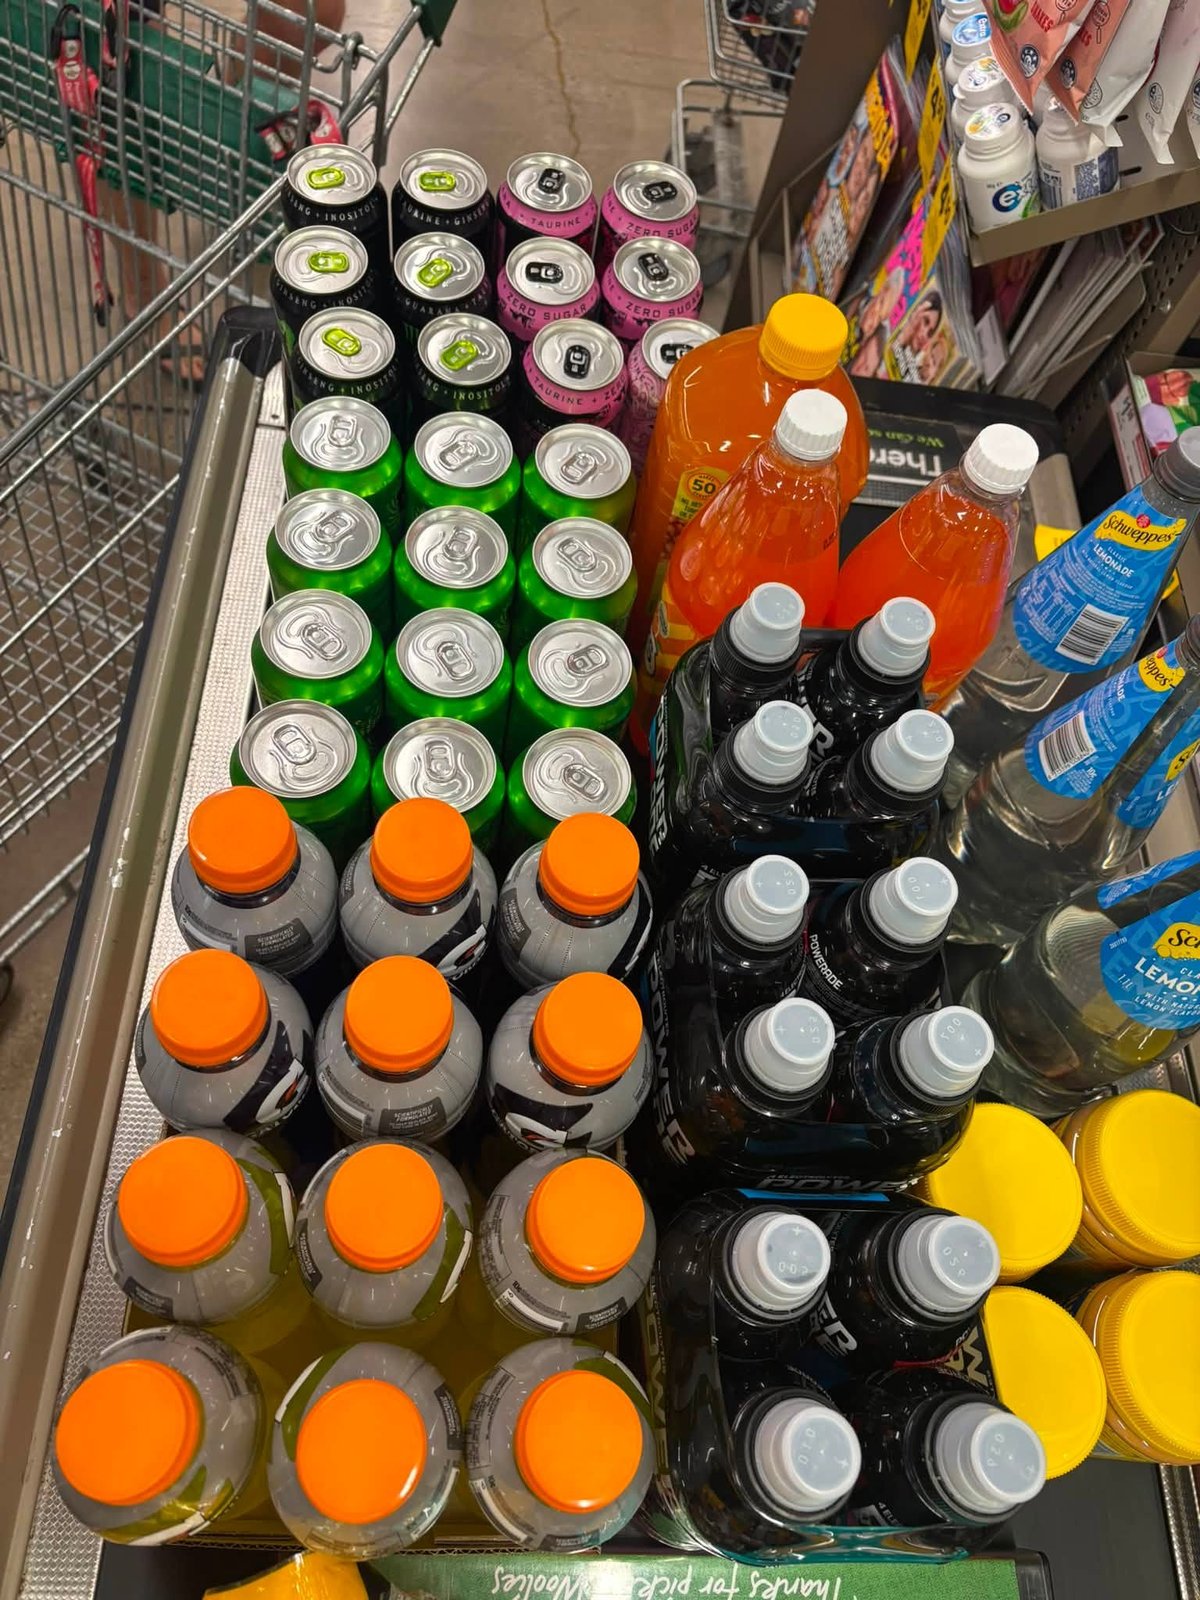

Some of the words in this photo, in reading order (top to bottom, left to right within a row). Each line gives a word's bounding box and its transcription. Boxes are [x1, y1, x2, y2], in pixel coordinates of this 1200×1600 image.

[626, 301, 660, 318] ZERO
[869, 447, 943, 477] Ther
[691, 478, 716, 495] 50
[1103, 514, 1171, 545] Schweppes
[1093, 543, 1135, 578] LEMONADE
[809, 934, 844, 990] POWERADE
[1134, 996, 1166, 1012] LEMON
[697, 1563, 740, 1600] for
[750, 1569, 842, 1600] Thanks
